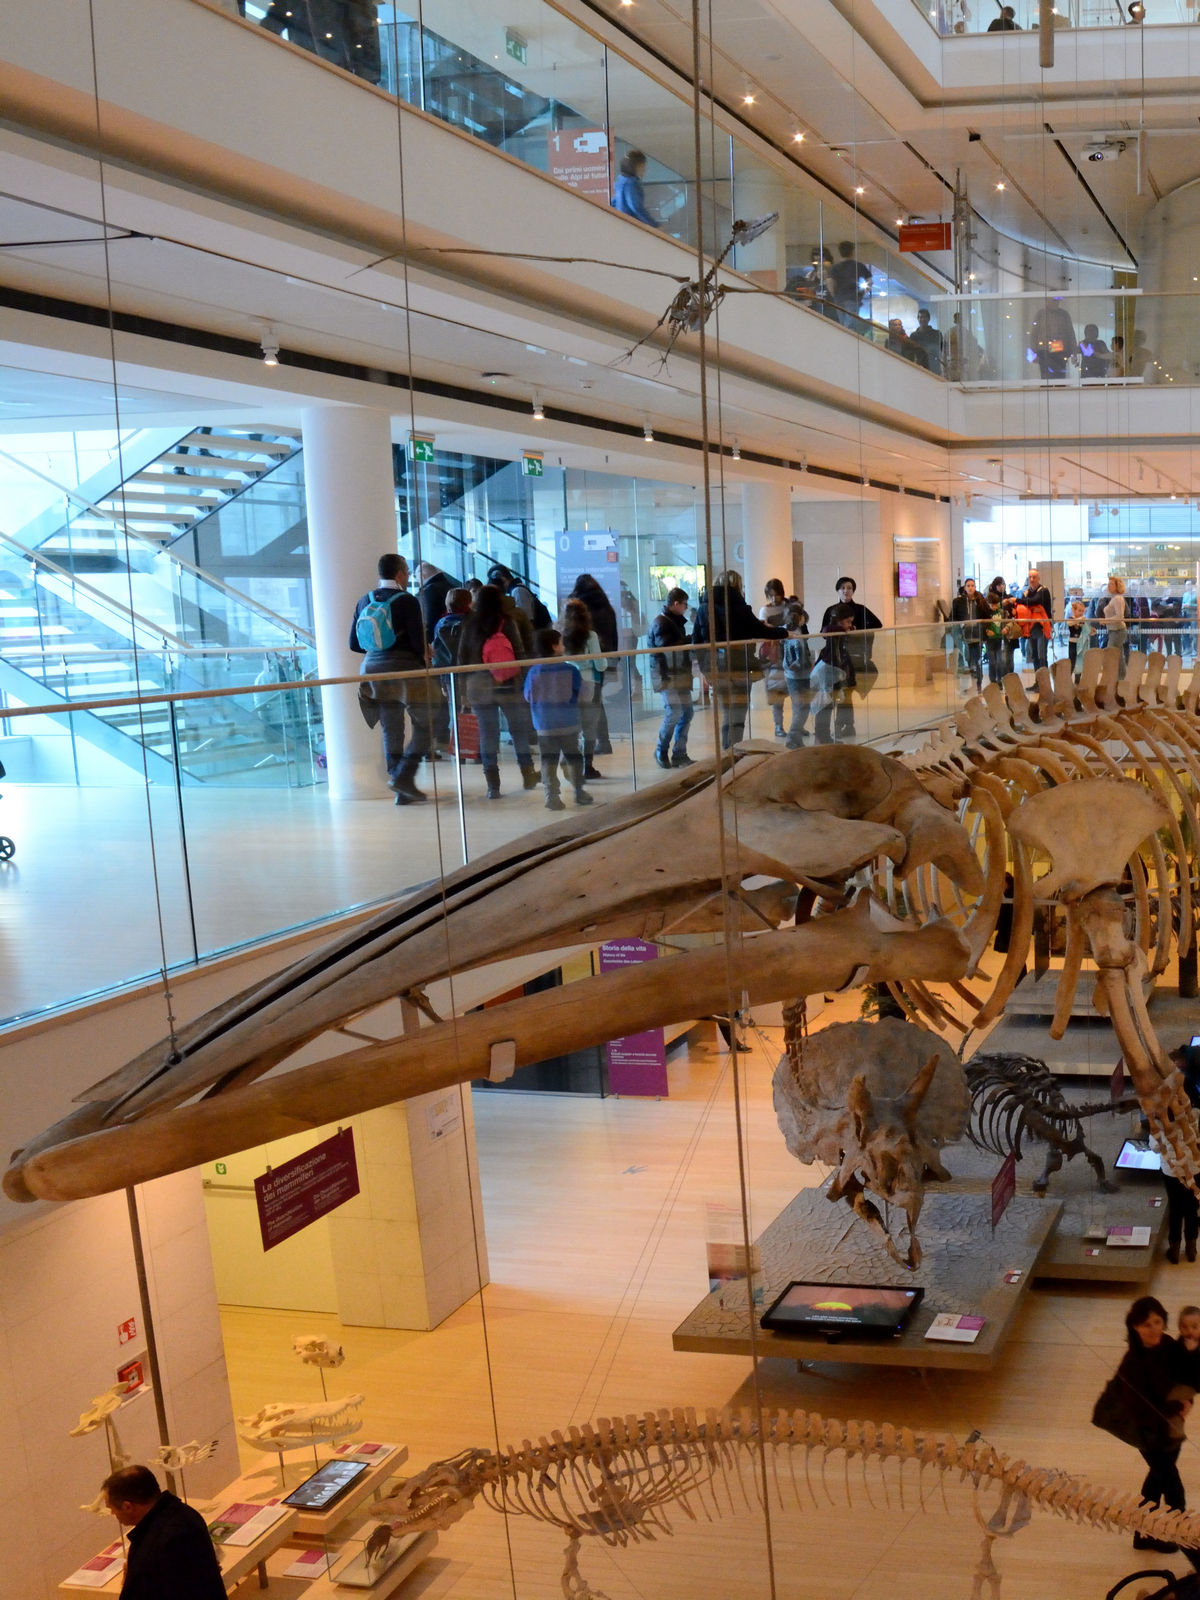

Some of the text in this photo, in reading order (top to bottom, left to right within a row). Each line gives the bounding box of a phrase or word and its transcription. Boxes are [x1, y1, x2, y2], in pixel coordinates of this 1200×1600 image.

[552, 135, 560, 153] 1
[560, 535, 570, 552] 0
[262, 1183, 272, 1194] La
[273, 1152, 327, 1187] diversificazione
[263, 1169, 315, 1203] dei mammiferi
